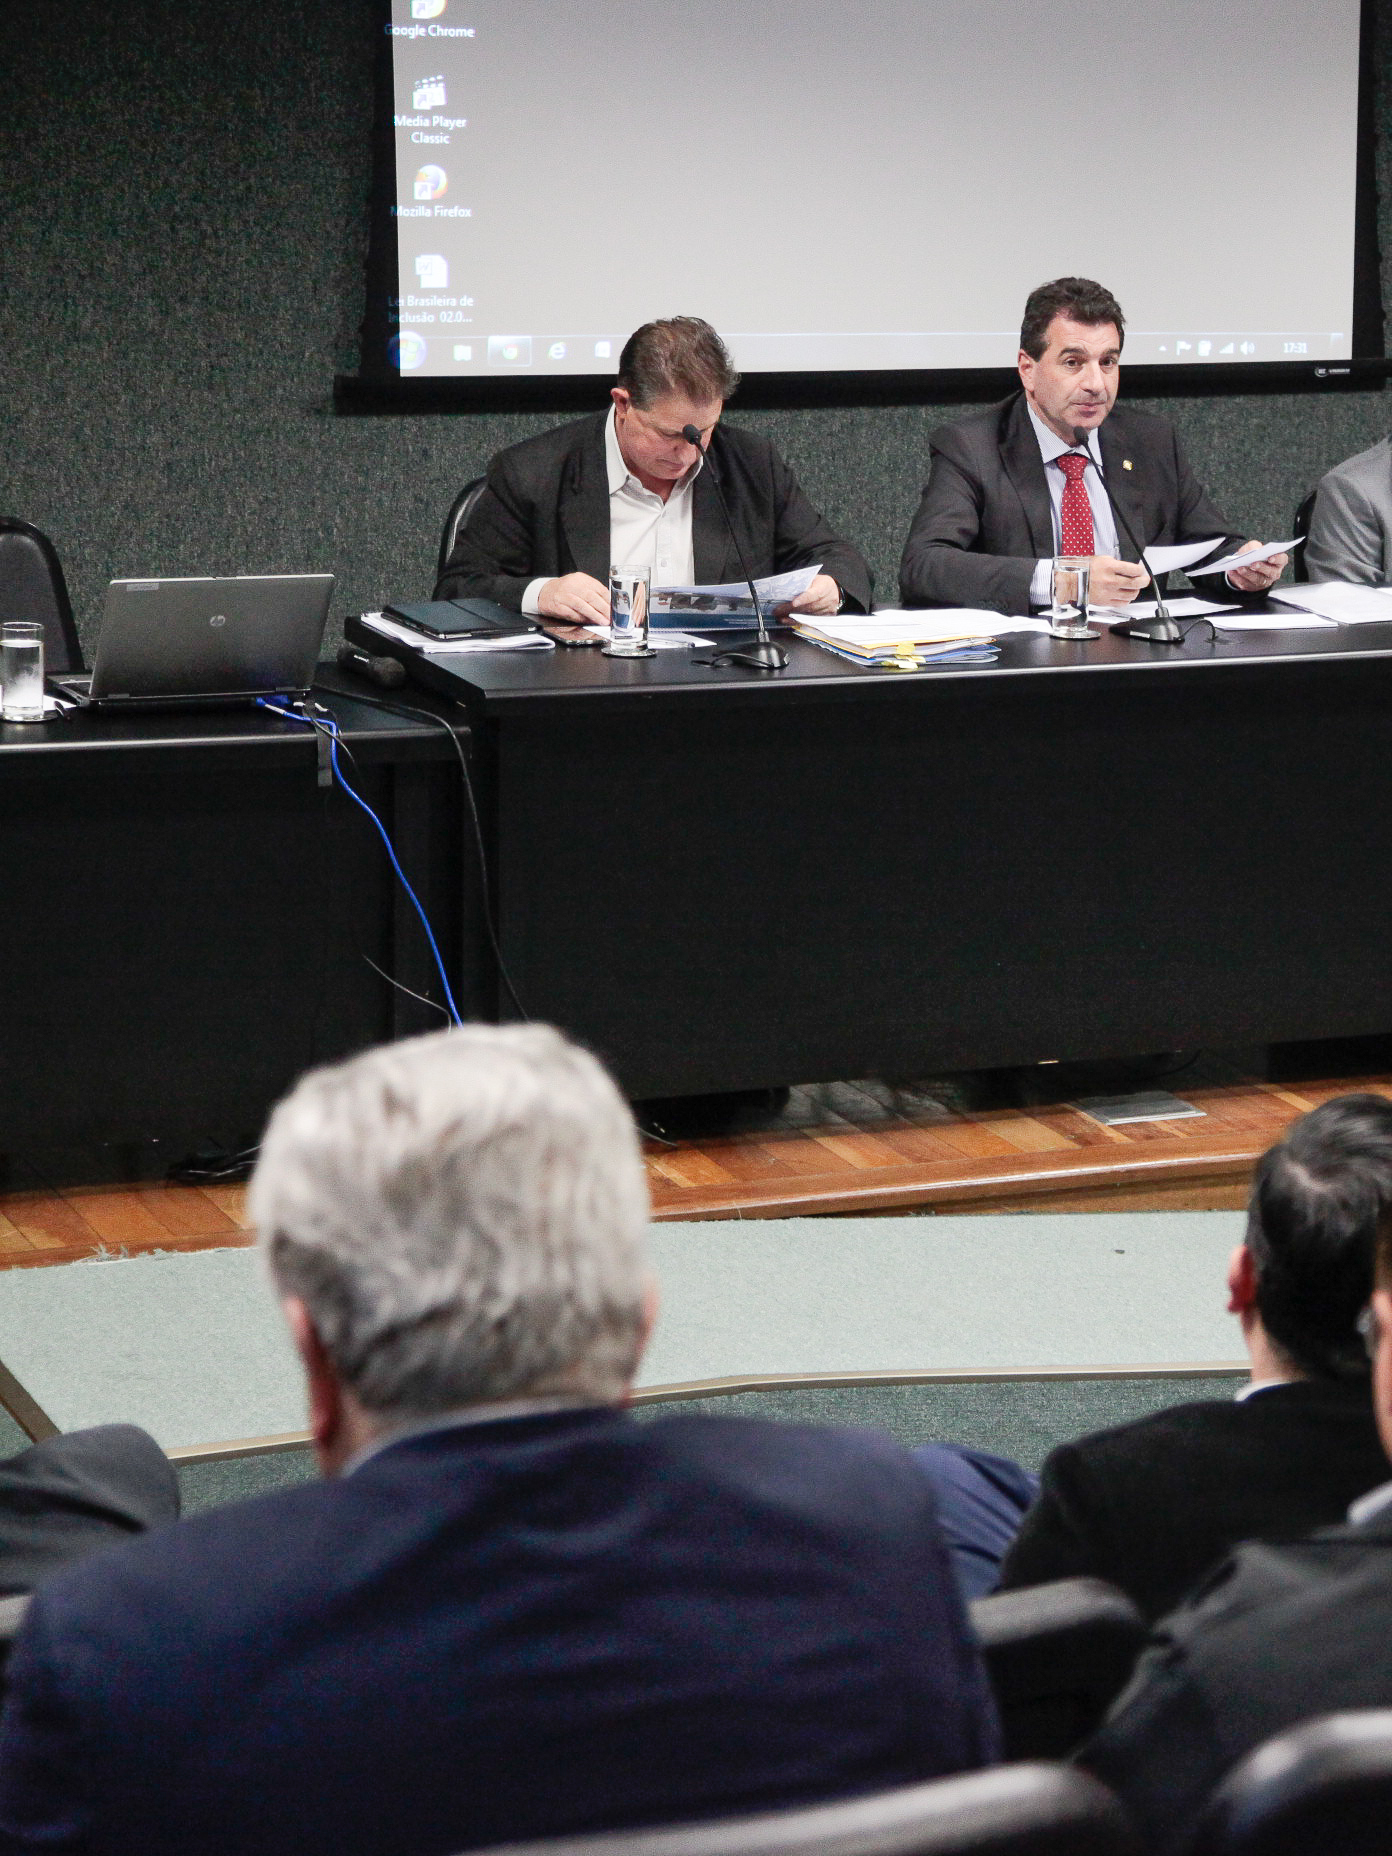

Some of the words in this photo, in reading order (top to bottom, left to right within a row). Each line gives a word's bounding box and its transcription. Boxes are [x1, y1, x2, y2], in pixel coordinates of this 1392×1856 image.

[384, 23, 426, 39] Google
[427, 24, 475, 38] Chrome
[393, 115, 430, 127] Media
[432, 115, 466, 130] Player
[411, 131, 450, 144] Classic
[390, 205, 431, 217] Mozilla
[434, 205, 472, 217] Firefox
[407, 294, 457, 307] Brasileira
[459, 293, 474, 307] de
